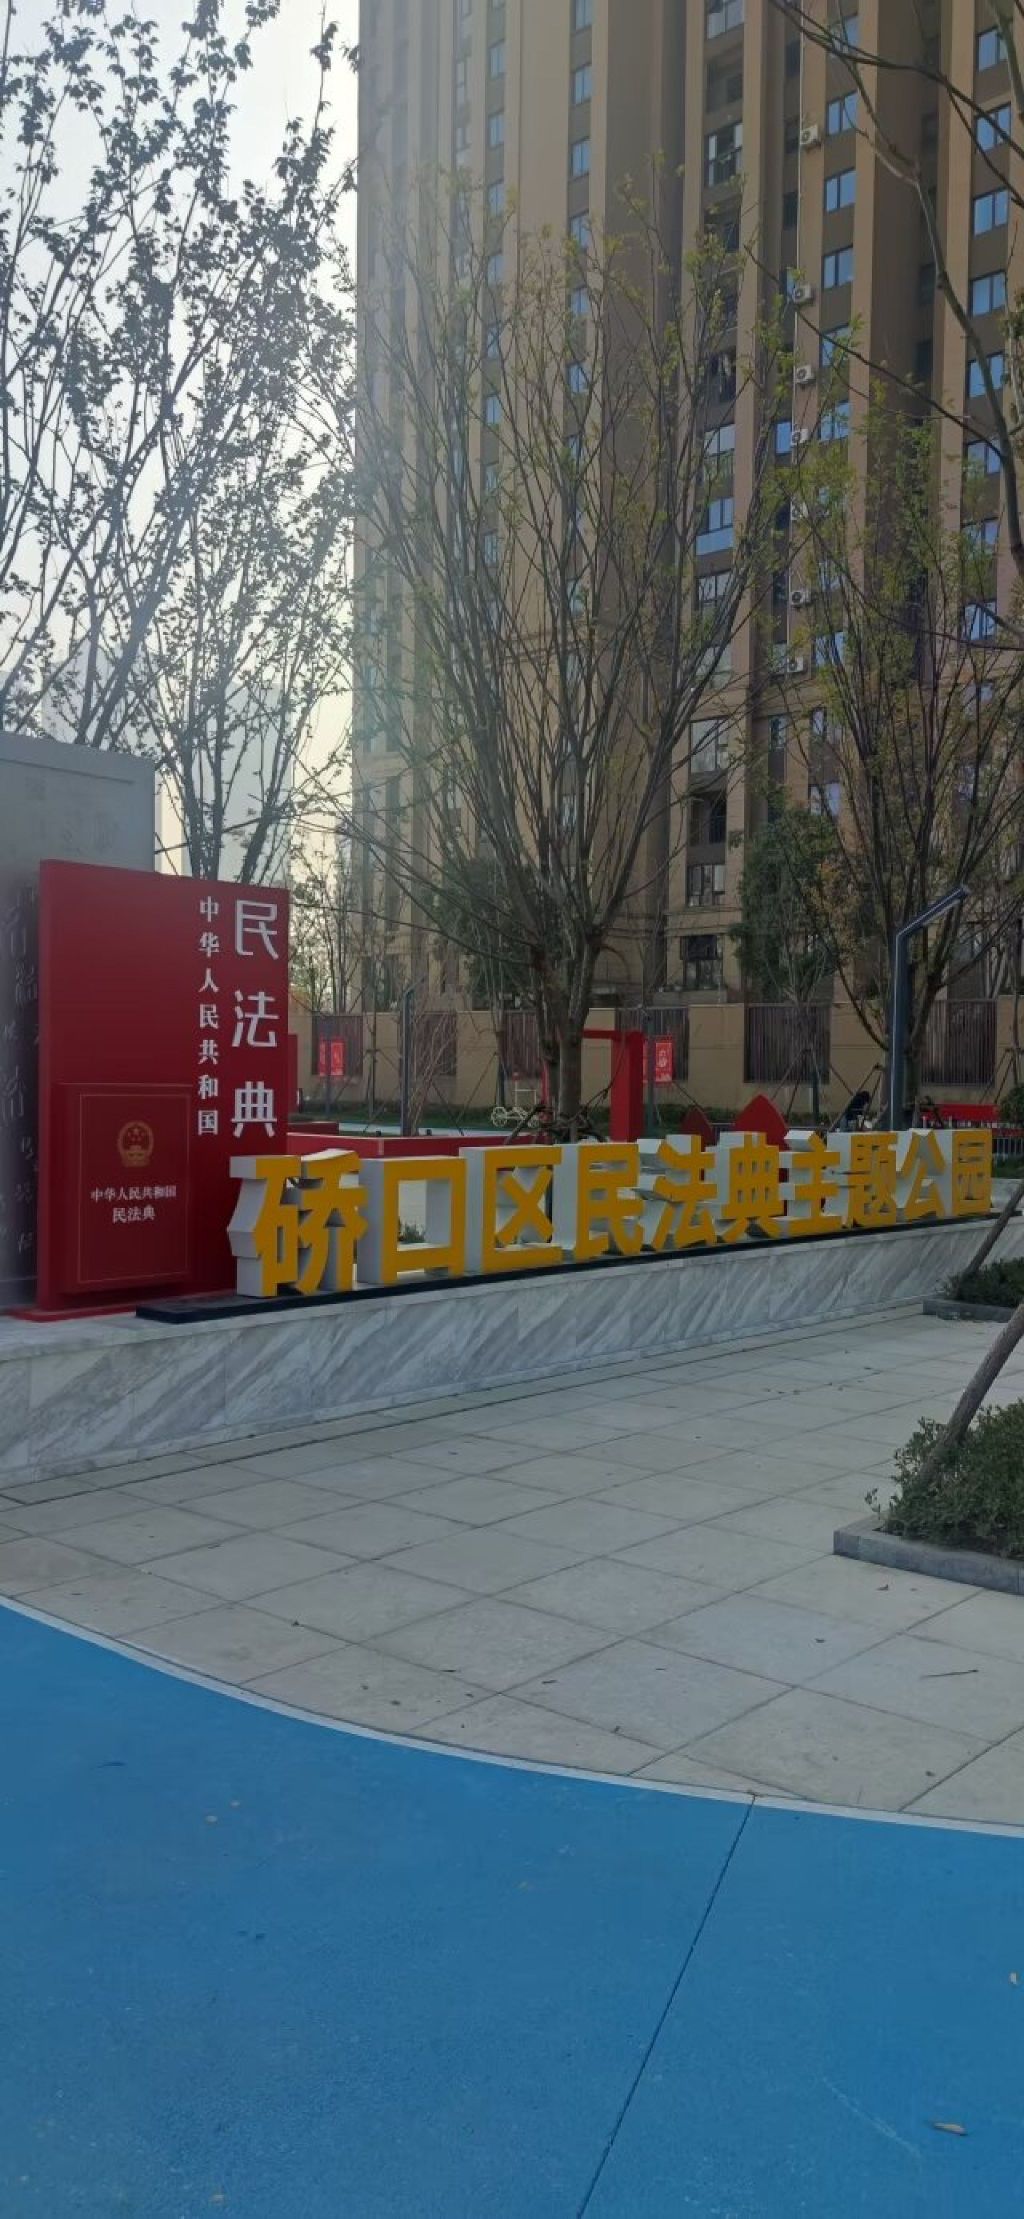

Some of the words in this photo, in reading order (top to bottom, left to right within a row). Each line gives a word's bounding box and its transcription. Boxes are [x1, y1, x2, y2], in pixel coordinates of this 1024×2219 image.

[198, 896, 219, 1136] 中华人民共和国
[231, 899, 279, 1138] 民法典
[90, 1185, 177, 1203] 中华人民共和国
[112, 1204, 156, 1224] 民法典
[248, 1128, 993, 1297] 硚口区民法典主题公园
